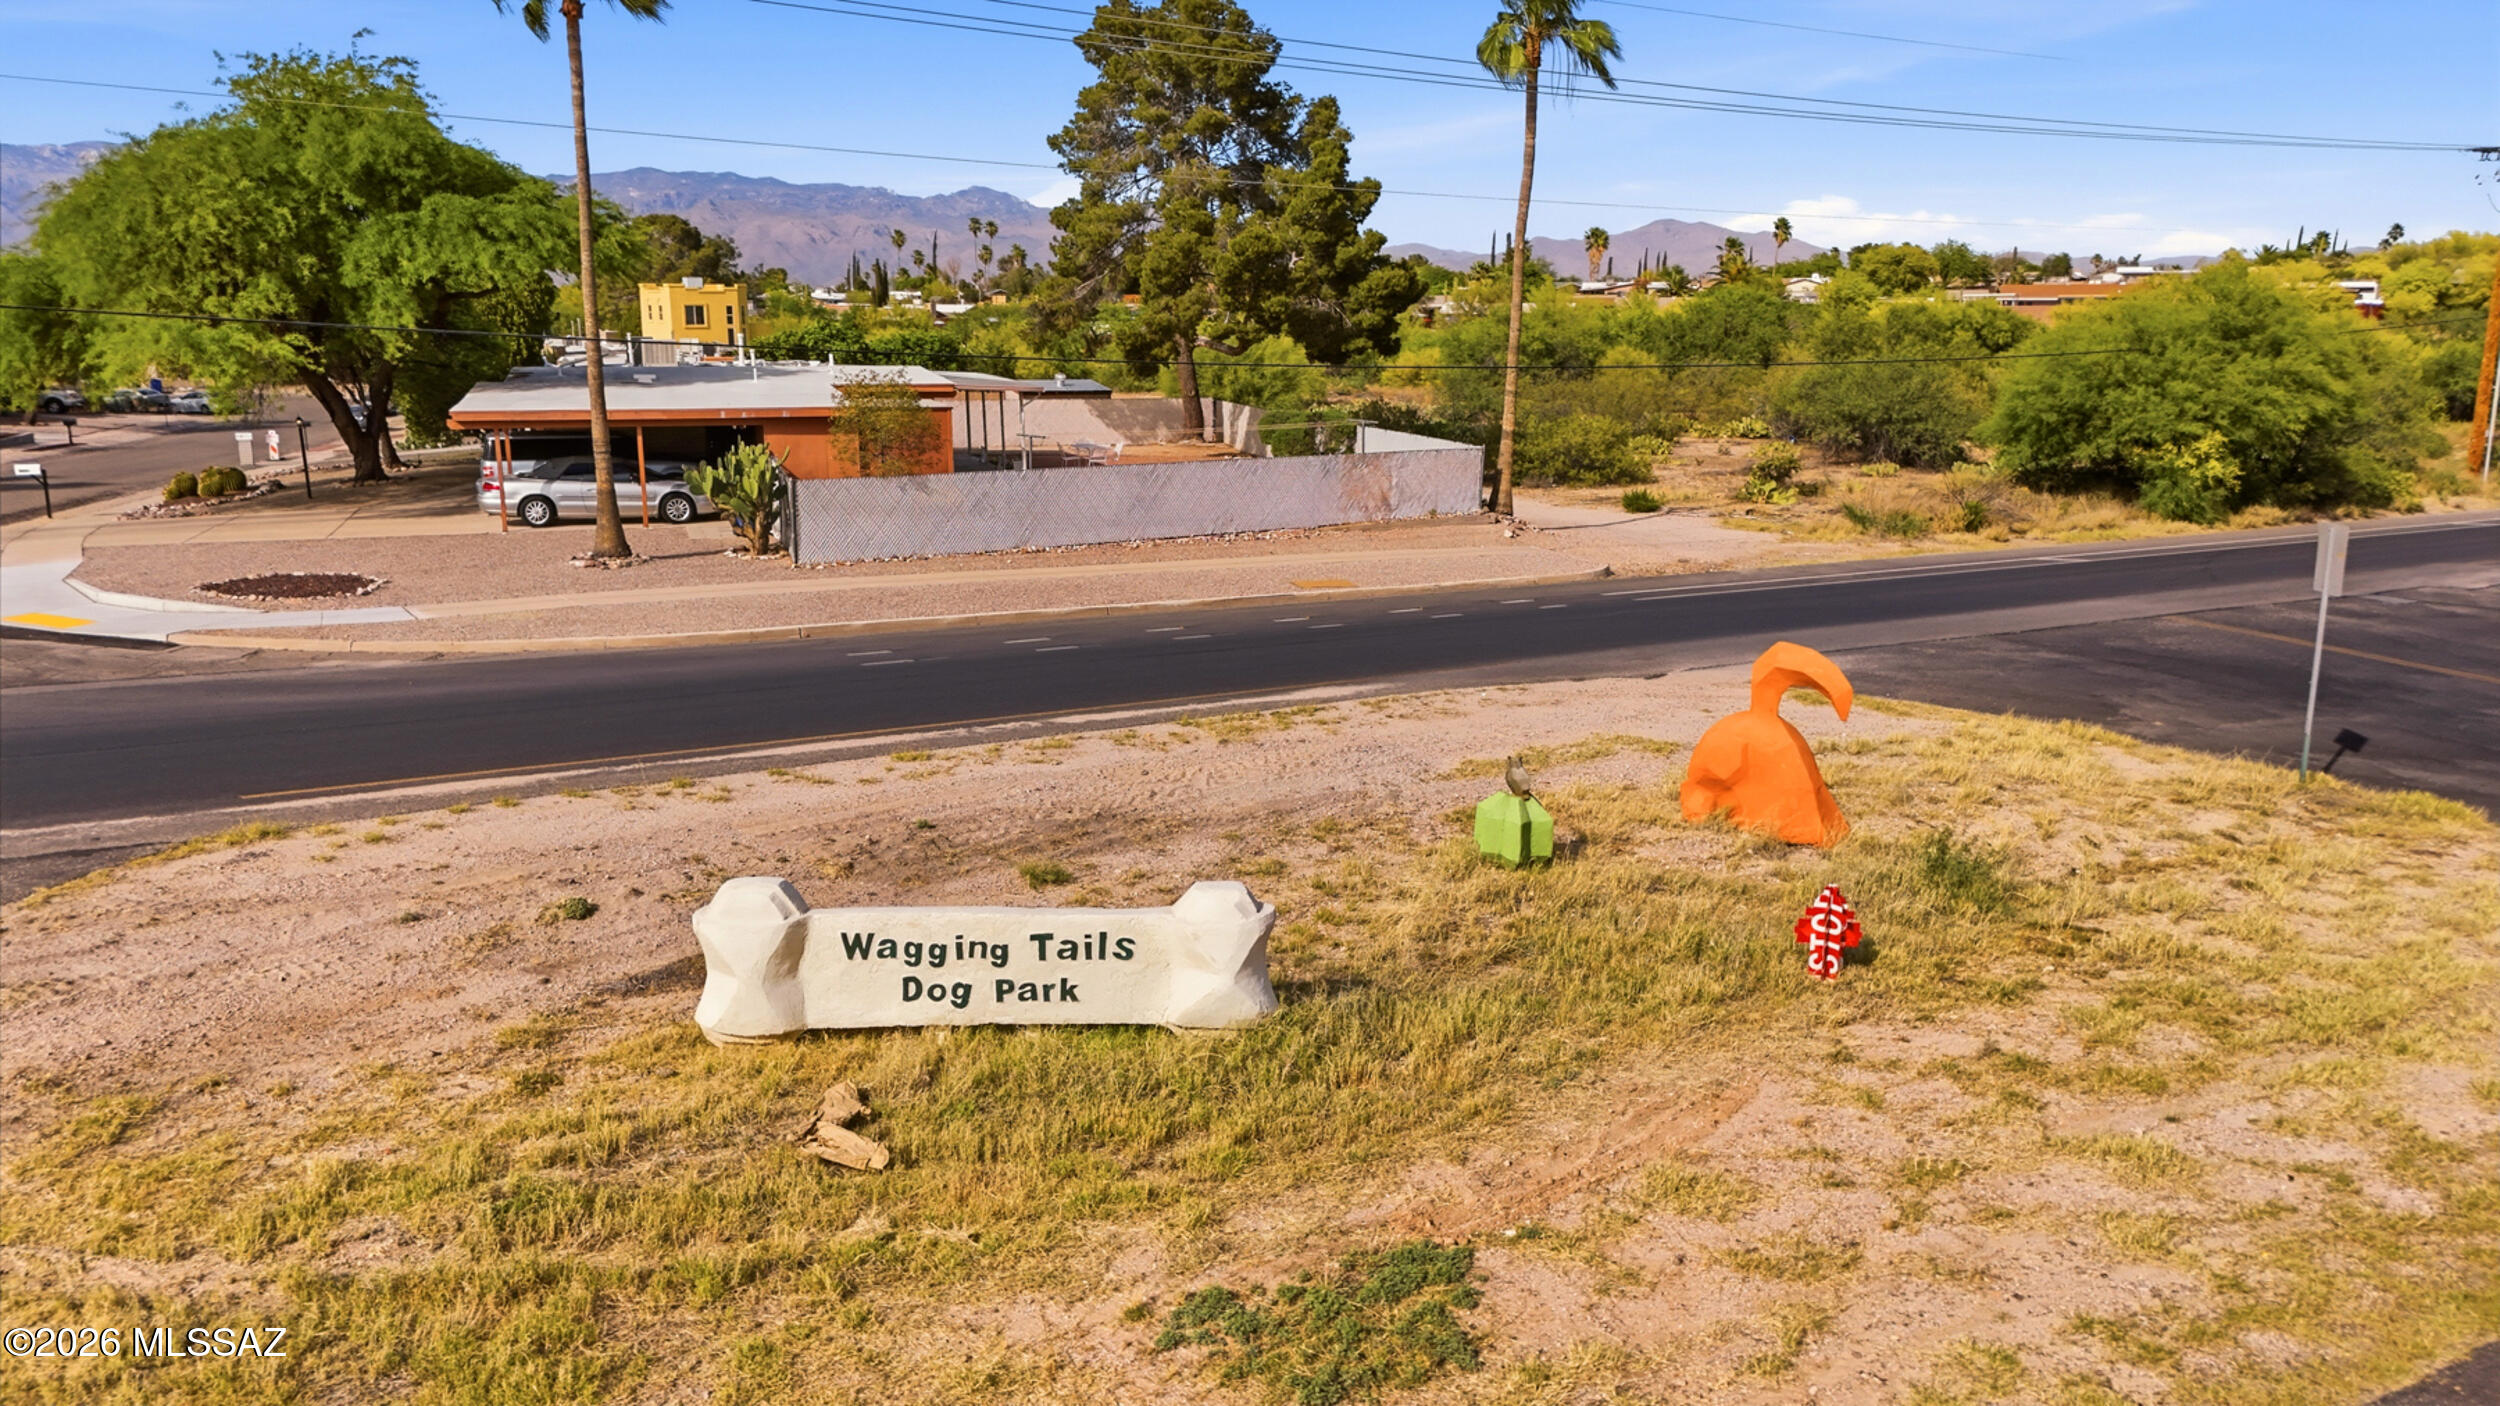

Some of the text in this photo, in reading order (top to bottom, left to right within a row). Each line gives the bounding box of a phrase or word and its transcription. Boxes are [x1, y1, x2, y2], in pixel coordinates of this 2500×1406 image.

[841, 931, 1136, 968] Wagging Tails
[902, 976, 1080, 1009] Dog Park
